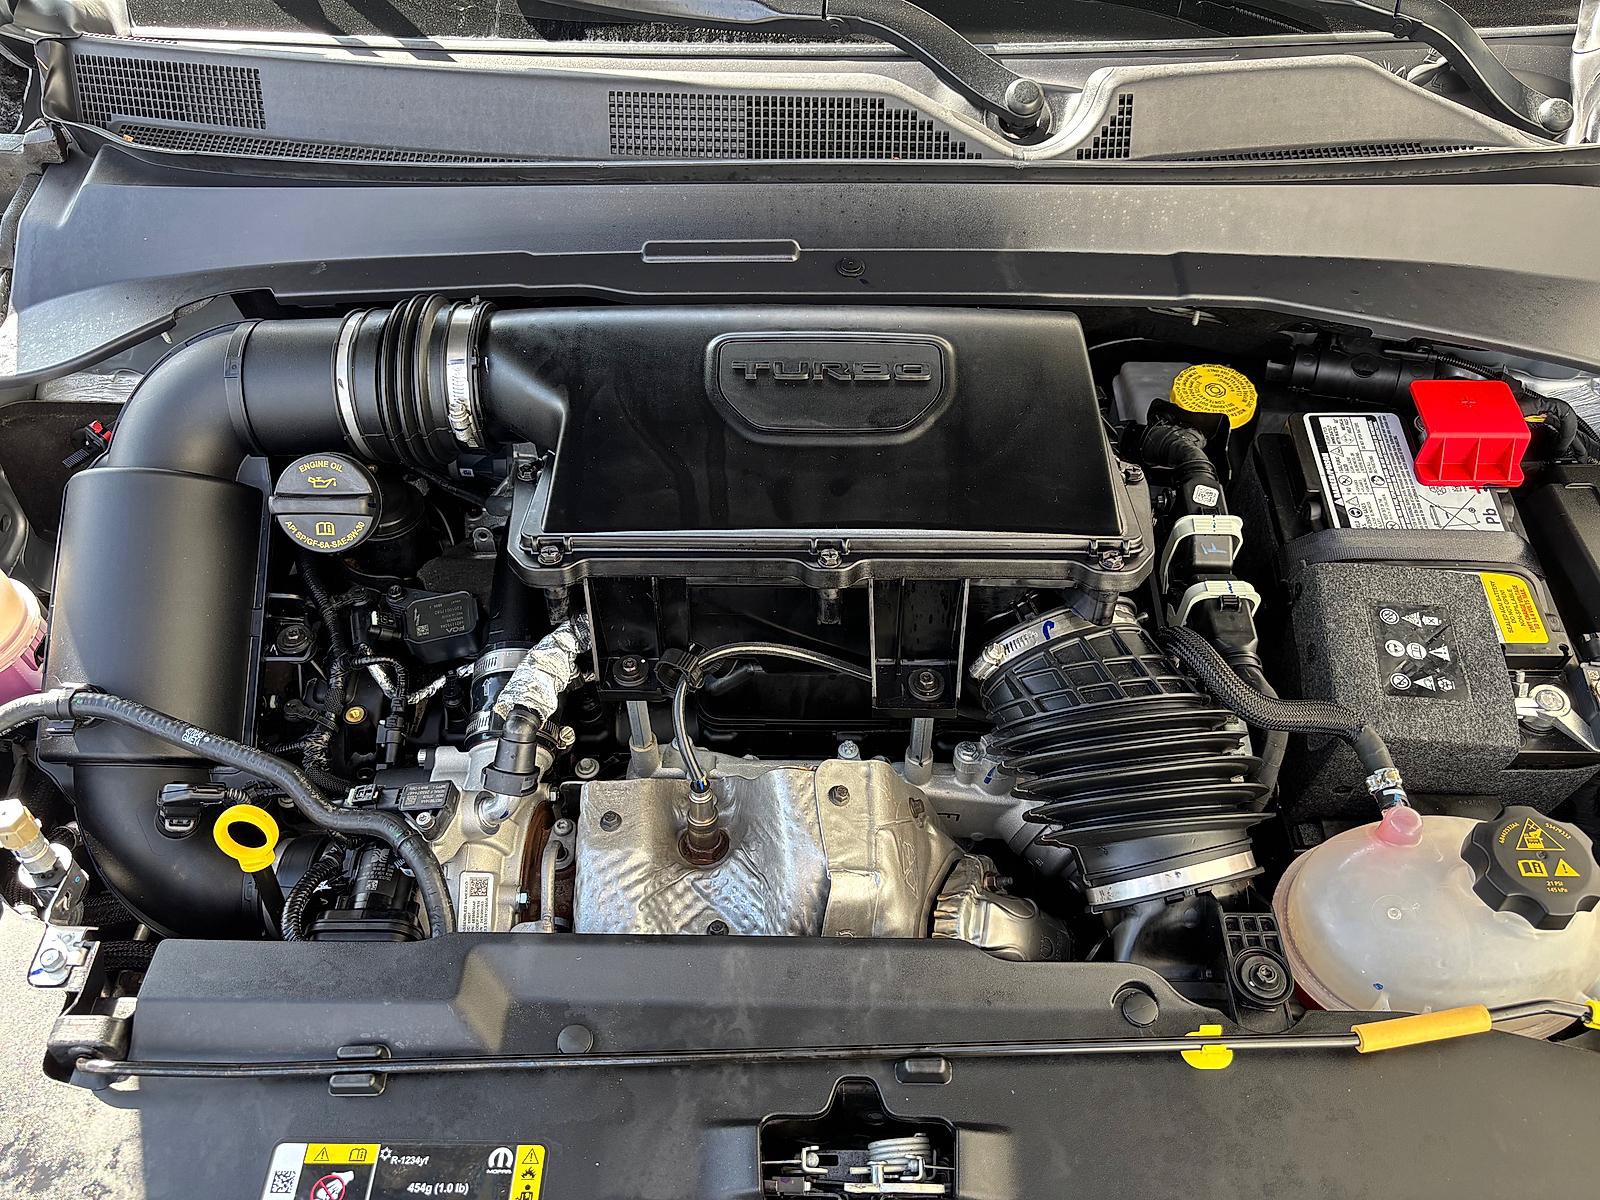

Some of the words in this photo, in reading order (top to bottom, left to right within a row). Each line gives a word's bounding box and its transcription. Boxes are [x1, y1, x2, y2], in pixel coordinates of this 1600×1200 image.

[732, 361, 932, 381] TURBO
[299, 461, 328, 472] ENGINE
[331, 462, 343, 472] OIL
[1483, 508, 1500, 524] Pb
[285, 521, 298, 533] API
[390, 1156, 429, 1166] R-1234yf
[407, 1183, 433, 1195] 454g
[434, 1183, 453, 1195] (1.0
[454, 1183, 469, 1195] lb)
